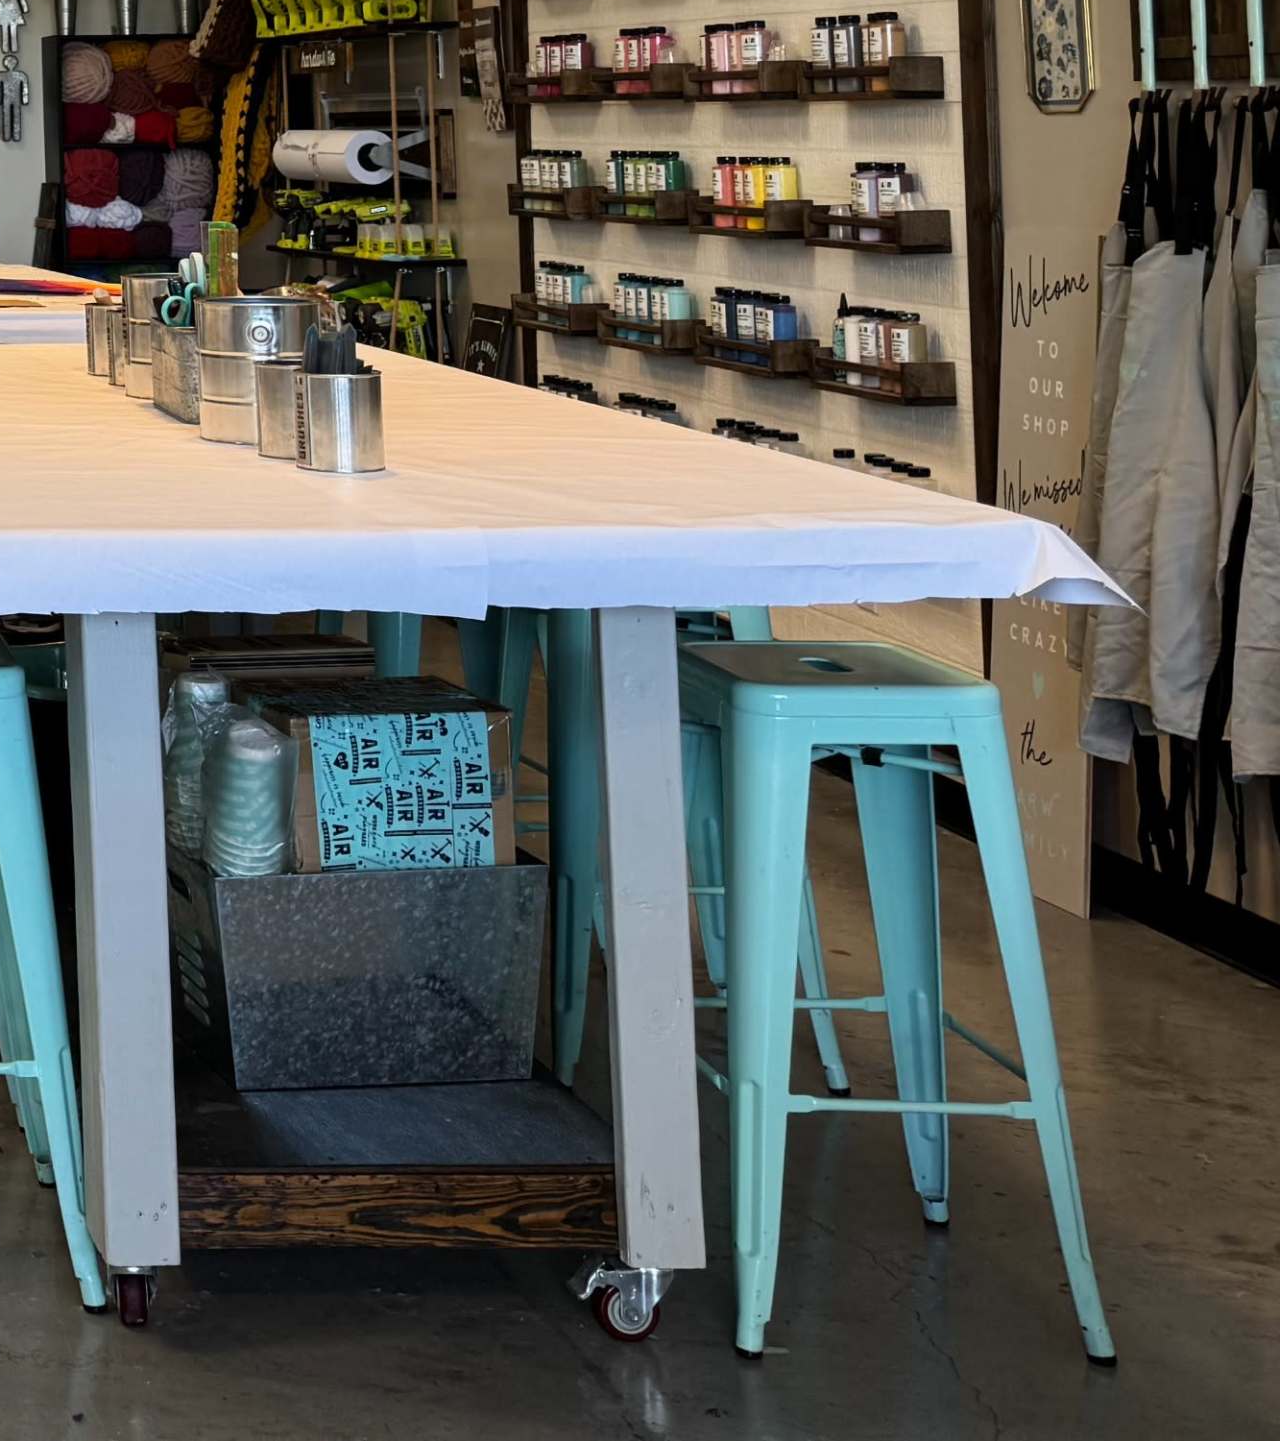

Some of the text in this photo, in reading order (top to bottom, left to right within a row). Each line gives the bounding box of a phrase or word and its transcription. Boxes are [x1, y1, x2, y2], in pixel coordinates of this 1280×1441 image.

[1009, 254, 1090, 328] Welcome
[1036, 339, 1059, 359] TO
[1028, 376, 1065, 399] OUR
[1022, 413, 1070, 437] SHOP
[1003, 448, 1086, 514] We missed
[1020, 719, 1053, 766] the
